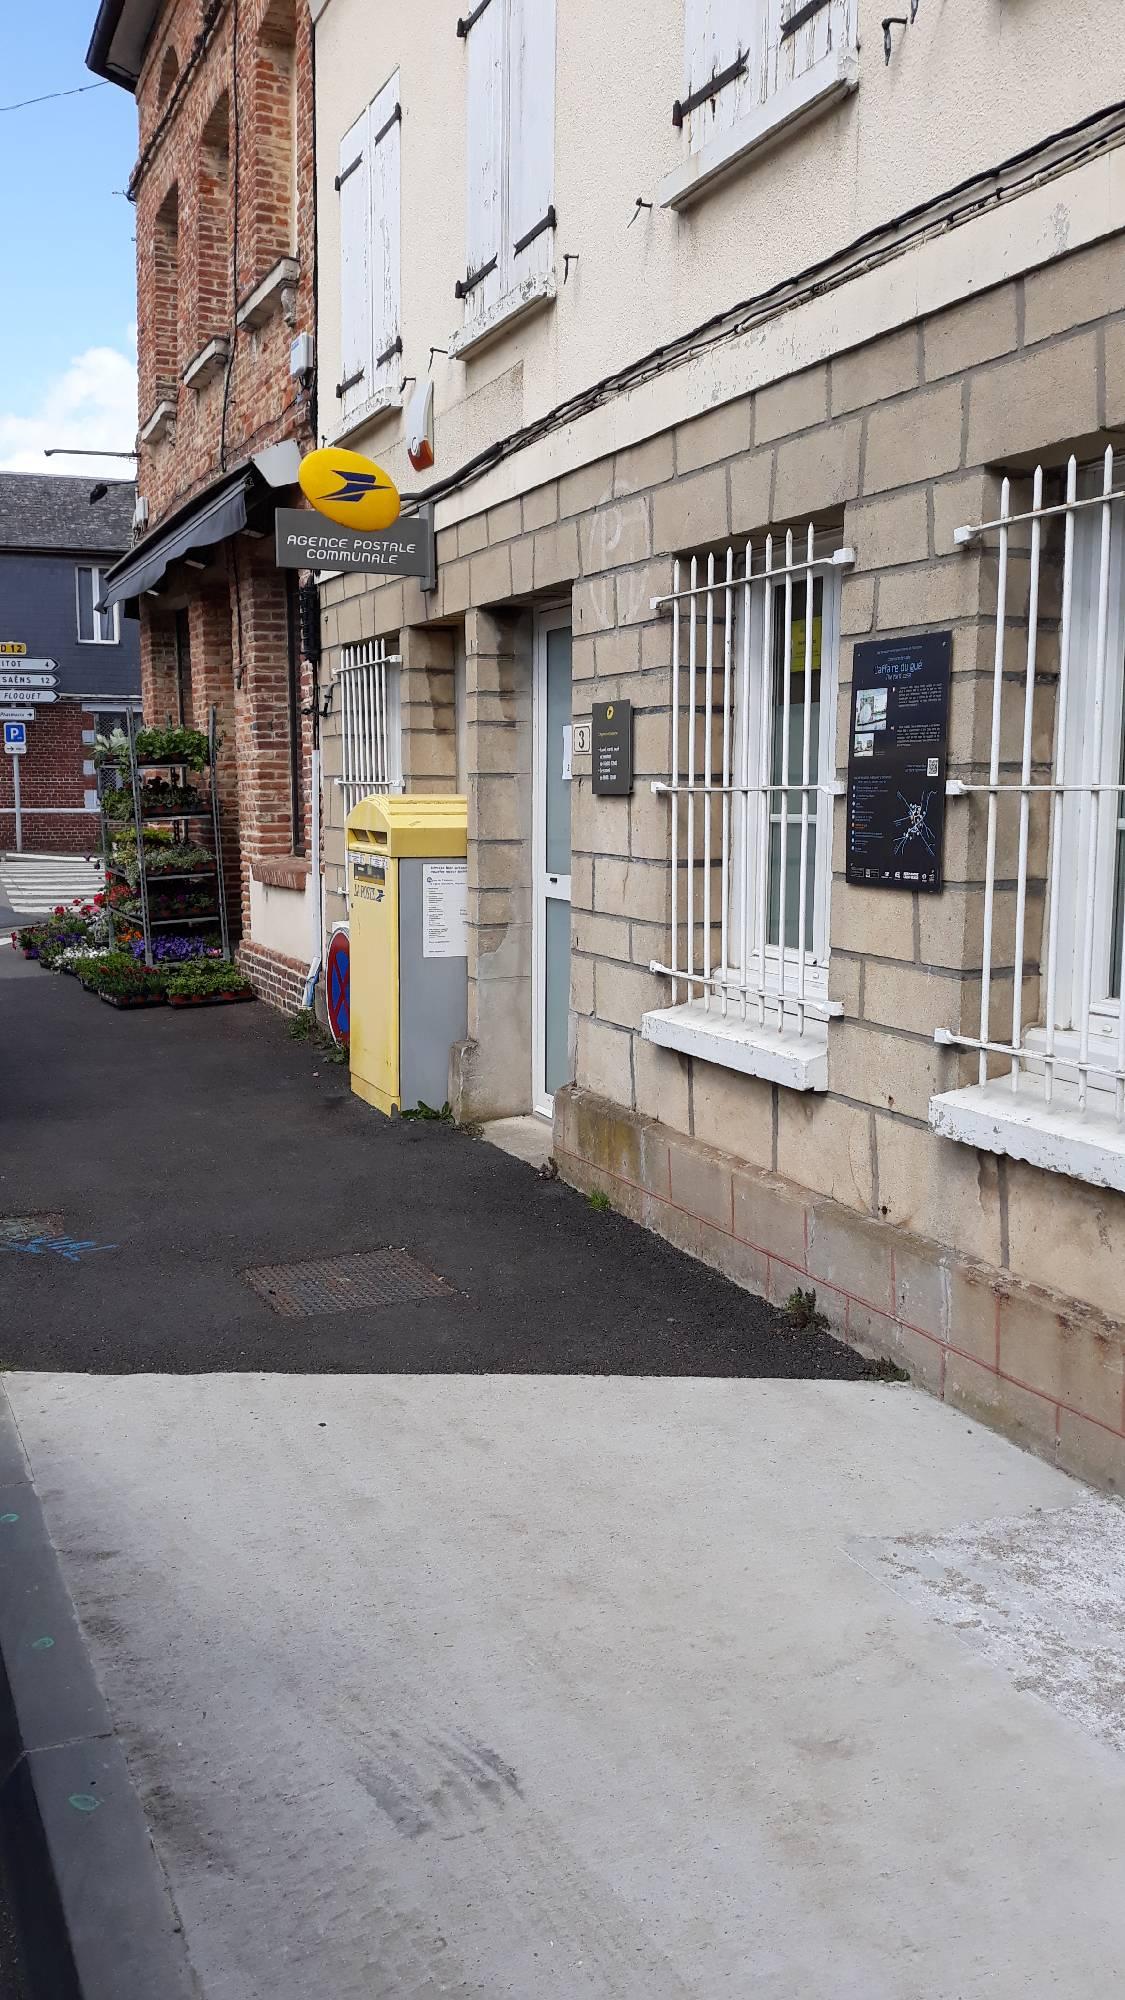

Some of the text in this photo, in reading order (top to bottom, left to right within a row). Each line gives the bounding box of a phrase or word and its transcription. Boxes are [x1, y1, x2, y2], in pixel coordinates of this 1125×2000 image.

[287, 534, 416, 553] AGENCE POSTALE
[306, 549, 398, 564] COMMUNALE
[0, 645, 22, 653] D 12
[2, 675, 50, 684] SAËNS 12
[4, 692, 41, 700] FLOQUET
[10, 727, 19, 740] P
[578, 730, 585, 749] 3
